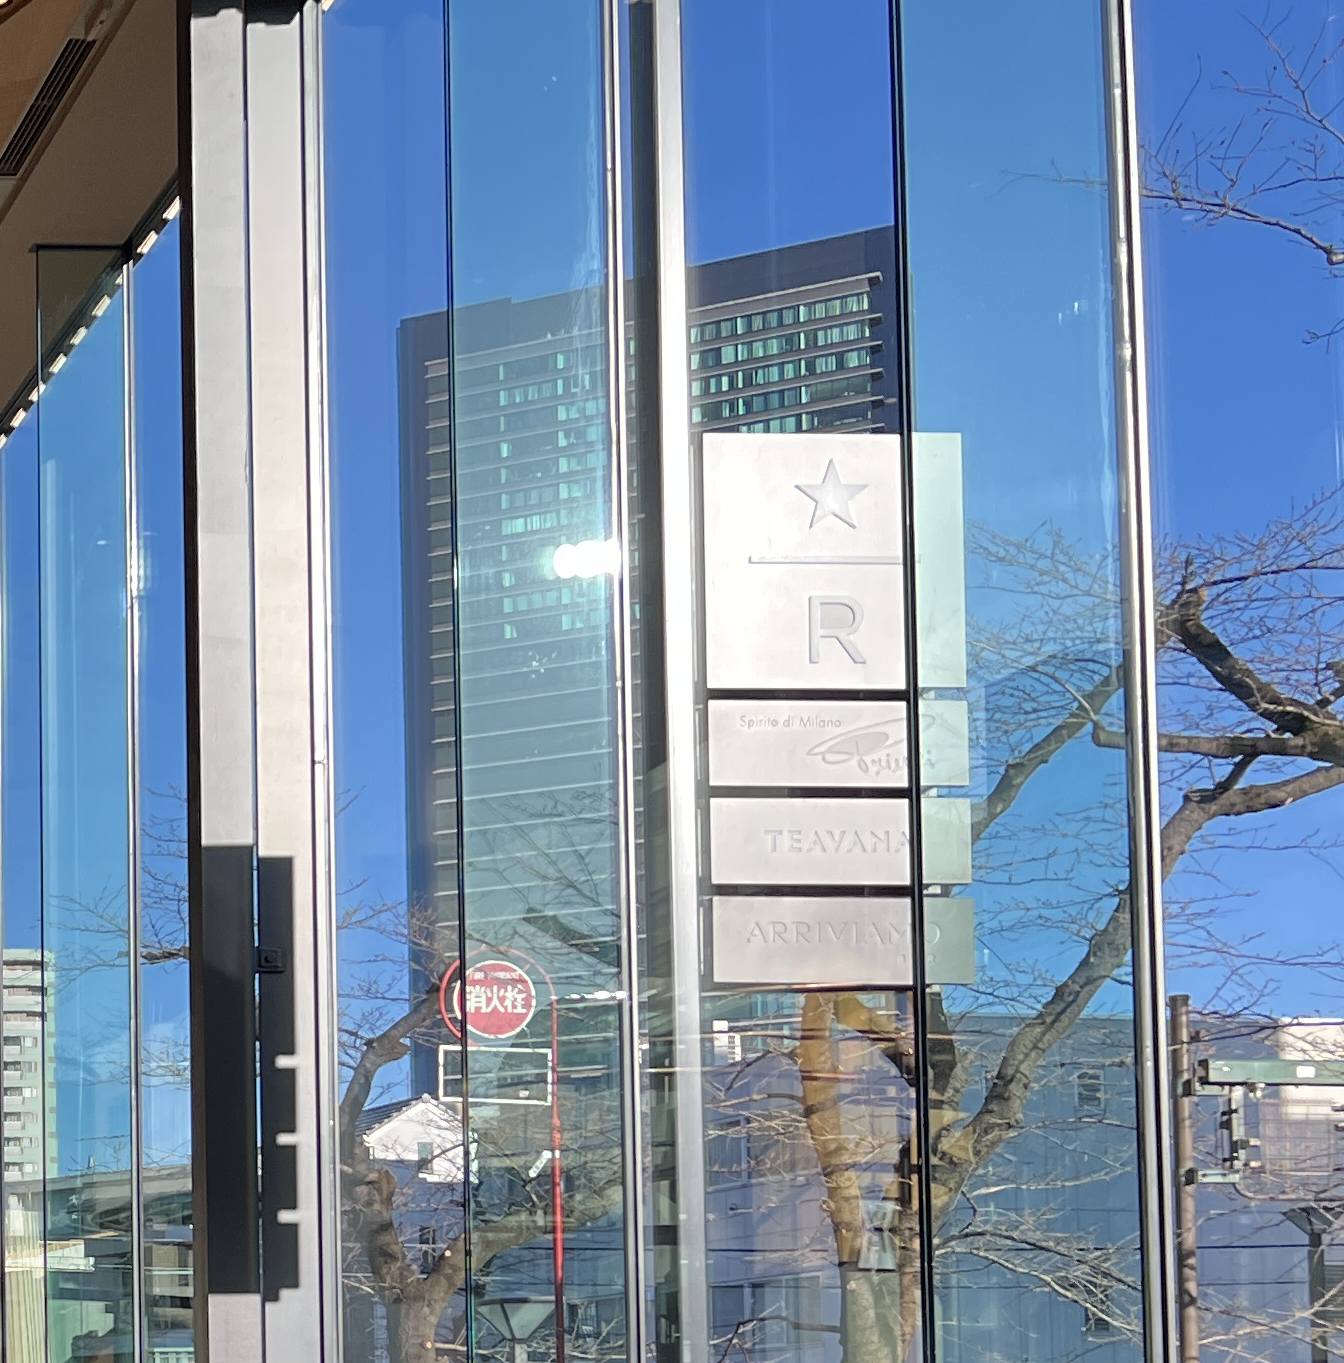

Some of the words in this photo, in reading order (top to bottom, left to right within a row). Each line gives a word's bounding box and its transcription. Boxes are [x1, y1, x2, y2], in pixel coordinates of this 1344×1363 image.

[808, 595, 866, 665] R
[739, 714, 778, 730] Spirito
[783, 714, 794, 729] di
[799, 715, 842, 729] Milano
[466, 984, 527, 1014] 消火栓
